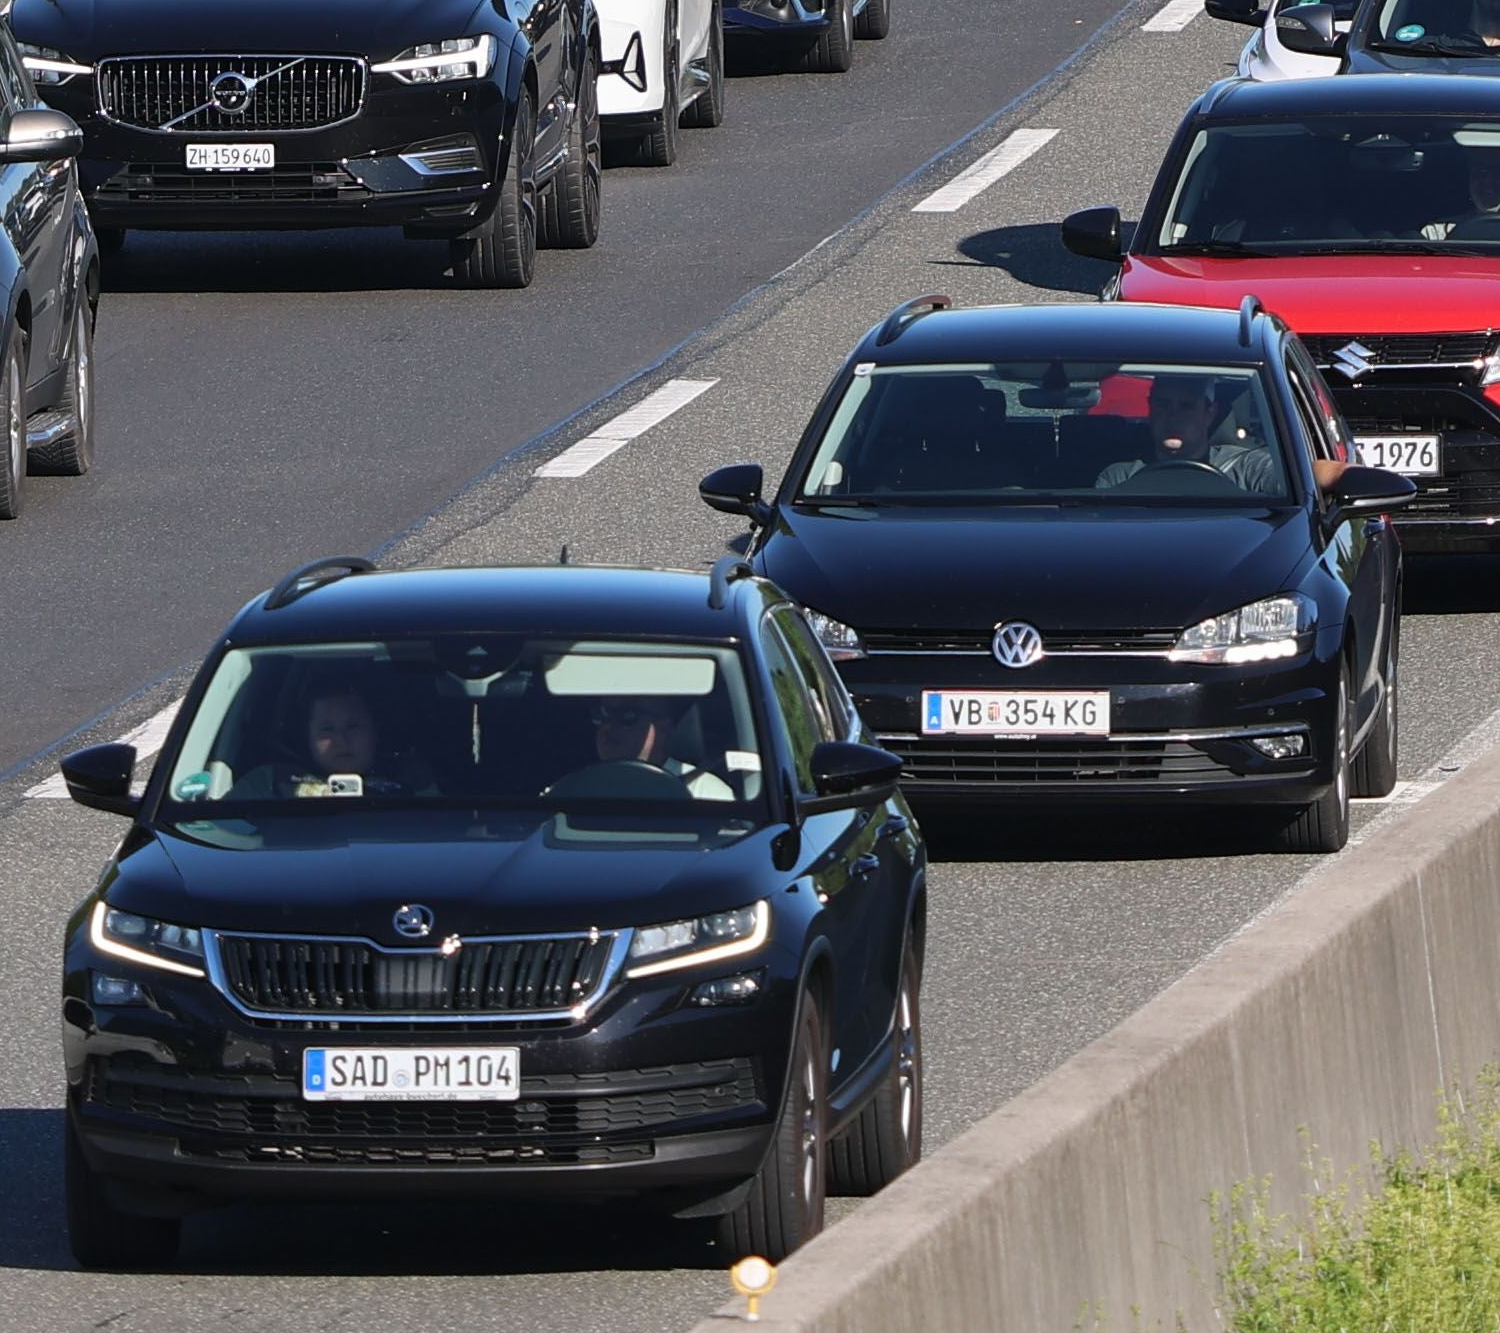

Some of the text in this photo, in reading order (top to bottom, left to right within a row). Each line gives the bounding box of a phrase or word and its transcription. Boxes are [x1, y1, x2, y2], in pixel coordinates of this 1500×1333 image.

[1373, 441, 1433, 469] 1976
[949, 699, 983, 726] VB
[1005, 699, 1057, 726] 354
[1063, 699, 1097, 726] KG
[331, 1056, 389, 1087] SAD
